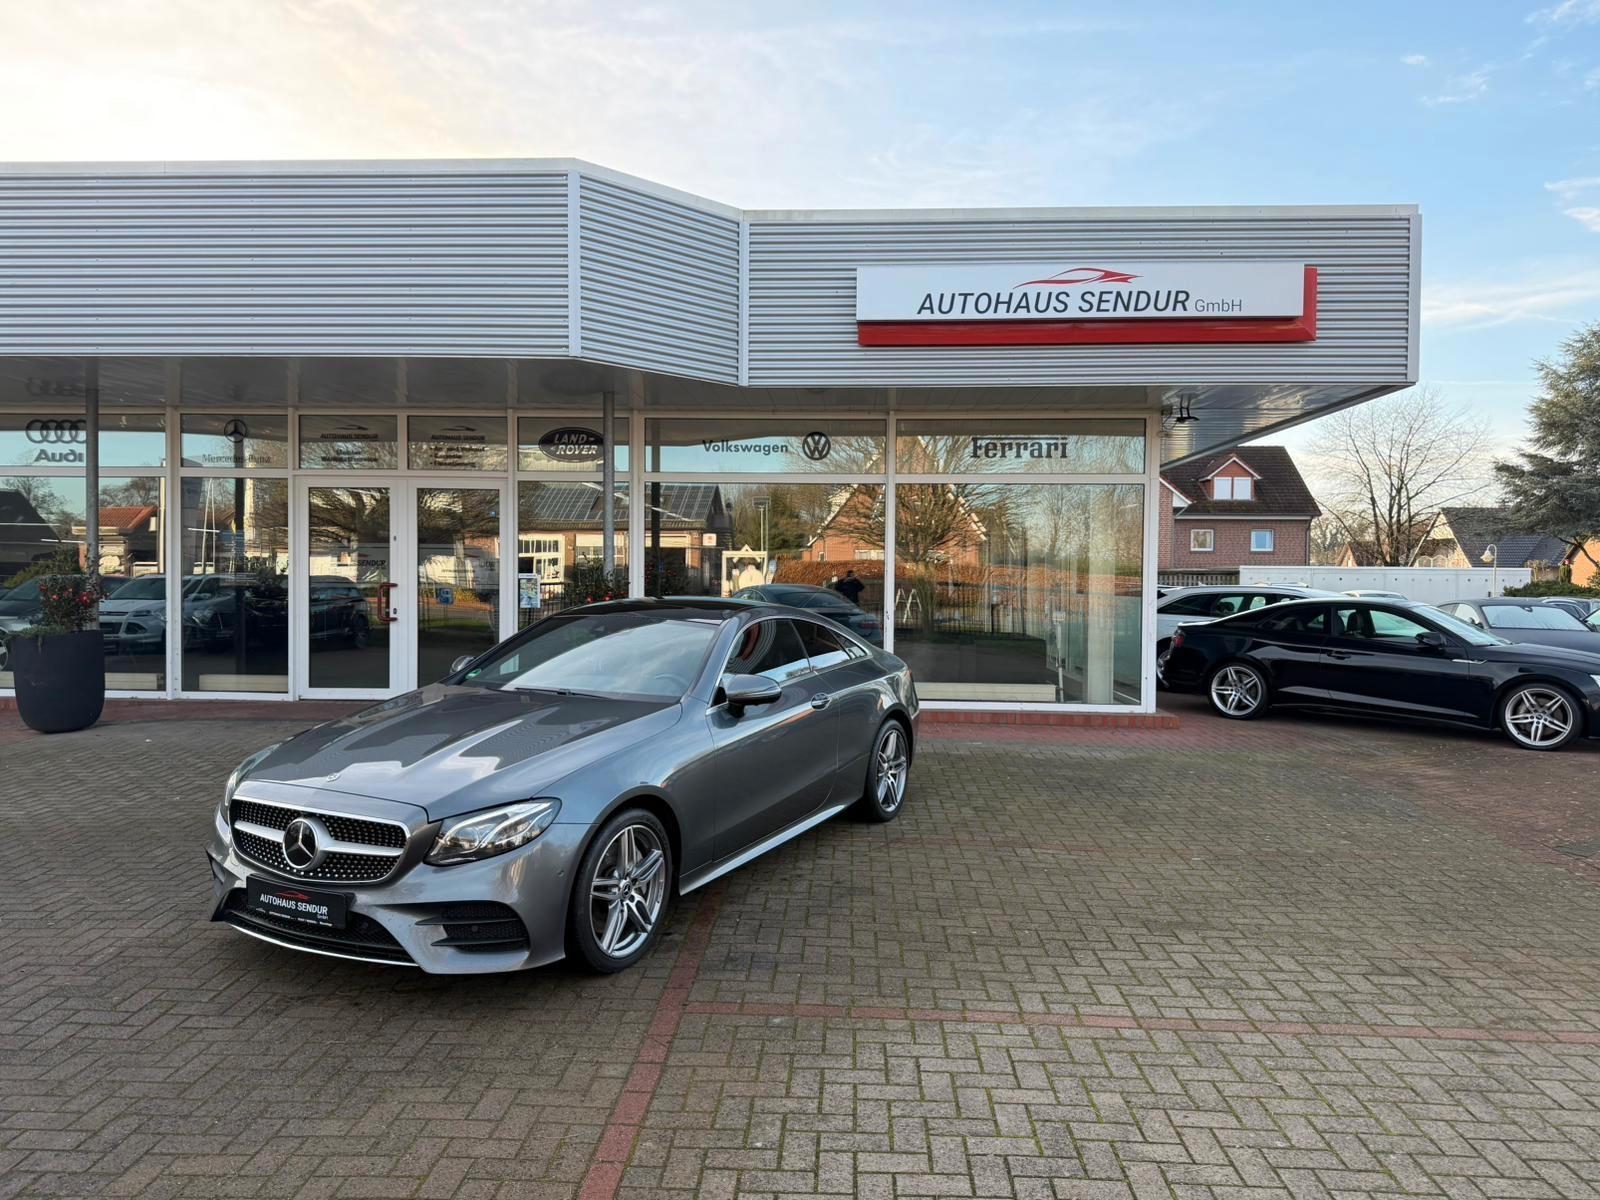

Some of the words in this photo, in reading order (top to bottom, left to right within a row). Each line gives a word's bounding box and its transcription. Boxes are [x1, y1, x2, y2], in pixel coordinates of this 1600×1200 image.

[917, 291, 1070, 315] AUTOHAUS
[1078, 290, 1190, 313] SENDUR
[1194, 299, 1243, 313] GmbH
[34, 448, 85, 463] Audi
[556, 445, 598, 455] ROVER
[702, 440, 788, 456] Volkswagen
[970, 437, 1069, 459] Ferrari
[260, 893, 296, 909] AUTOHAUS
[297, 902, 328, 915] SENDUR
